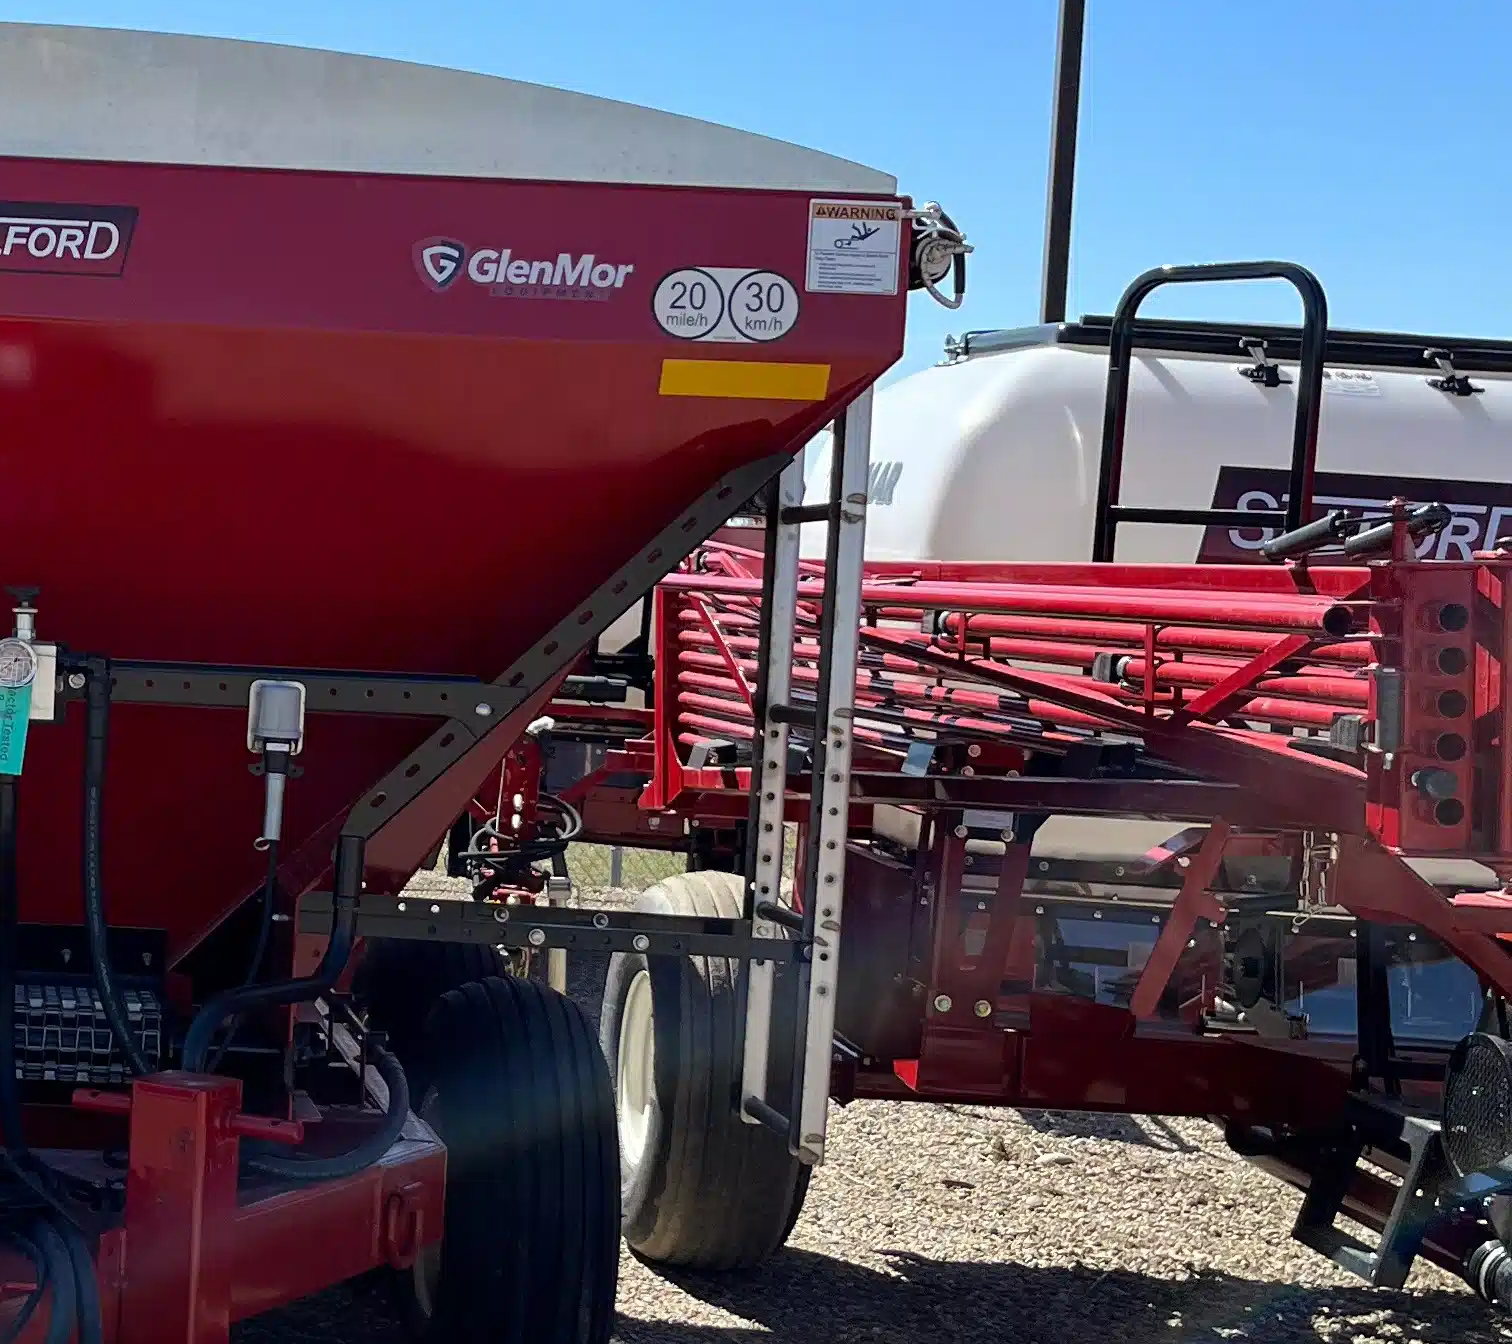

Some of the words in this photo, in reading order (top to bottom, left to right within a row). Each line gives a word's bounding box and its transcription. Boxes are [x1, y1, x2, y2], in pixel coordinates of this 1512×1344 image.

[826, 207, 896, 220] WARNING
[467, 248, 634, 288] GlenMor
[669, 281, 706, 310] 20
[745, 282, 785, 313] 30
[666, 313, 708, 327] mile/h
[745, 316, 783, 331] km/h
